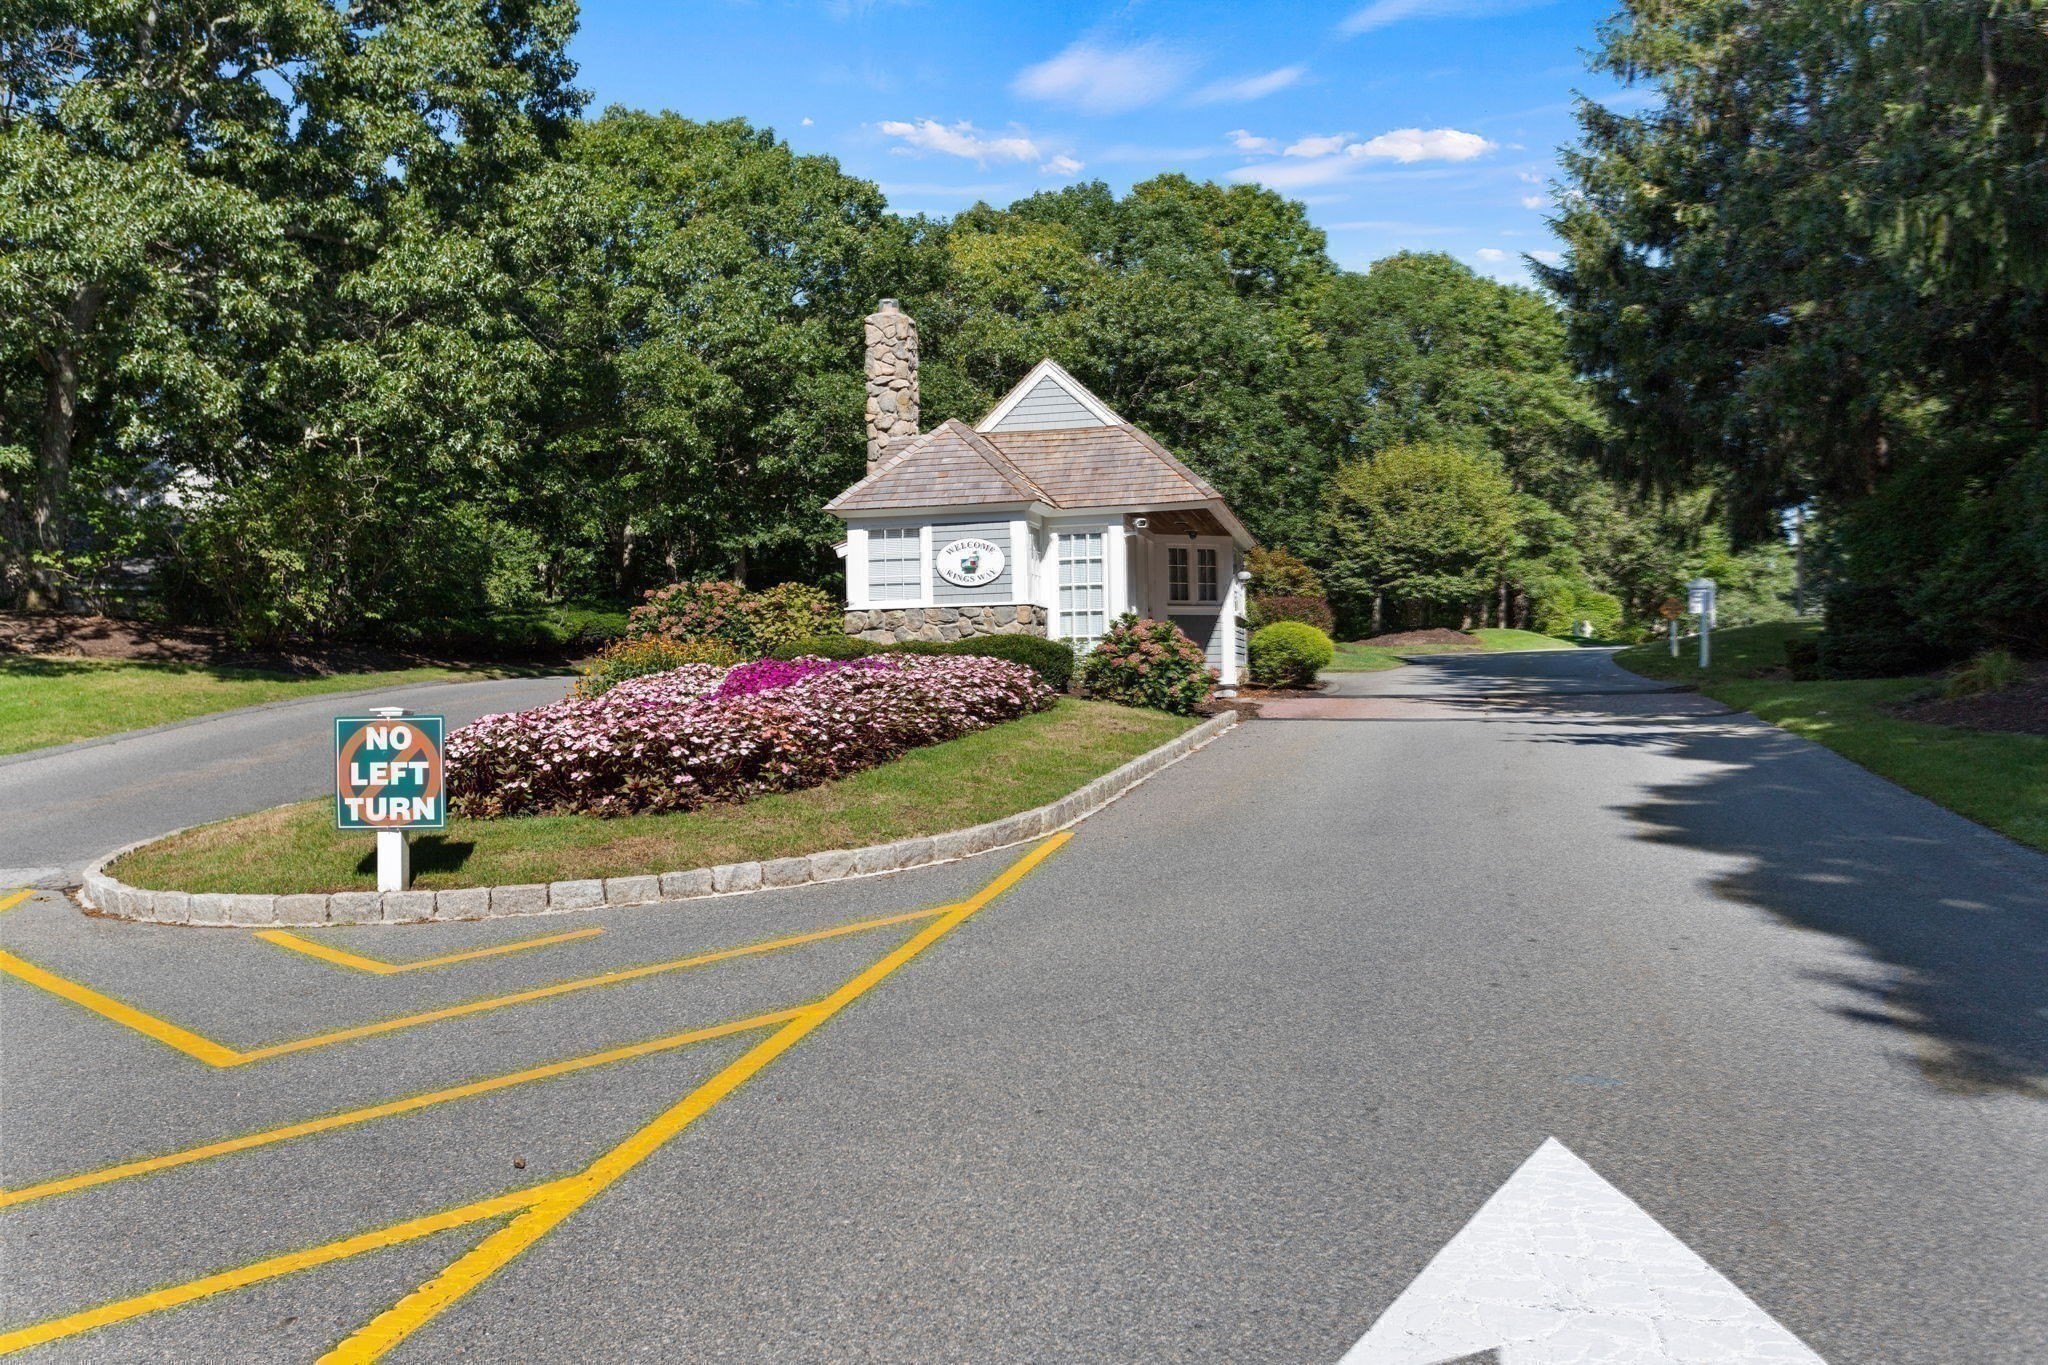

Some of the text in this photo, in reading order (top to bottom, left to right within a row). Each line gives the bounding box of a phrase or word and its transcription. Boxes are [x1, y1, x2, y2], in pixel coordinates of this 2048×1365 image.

[946, 541, 996, 555] WELCOME
[946, 569, 996, 583] KINGS WAY
[366, 726, 412, 750] NO
[350, 761, 429, 786] LEFT
[344, 797, 435, 821] TURN
